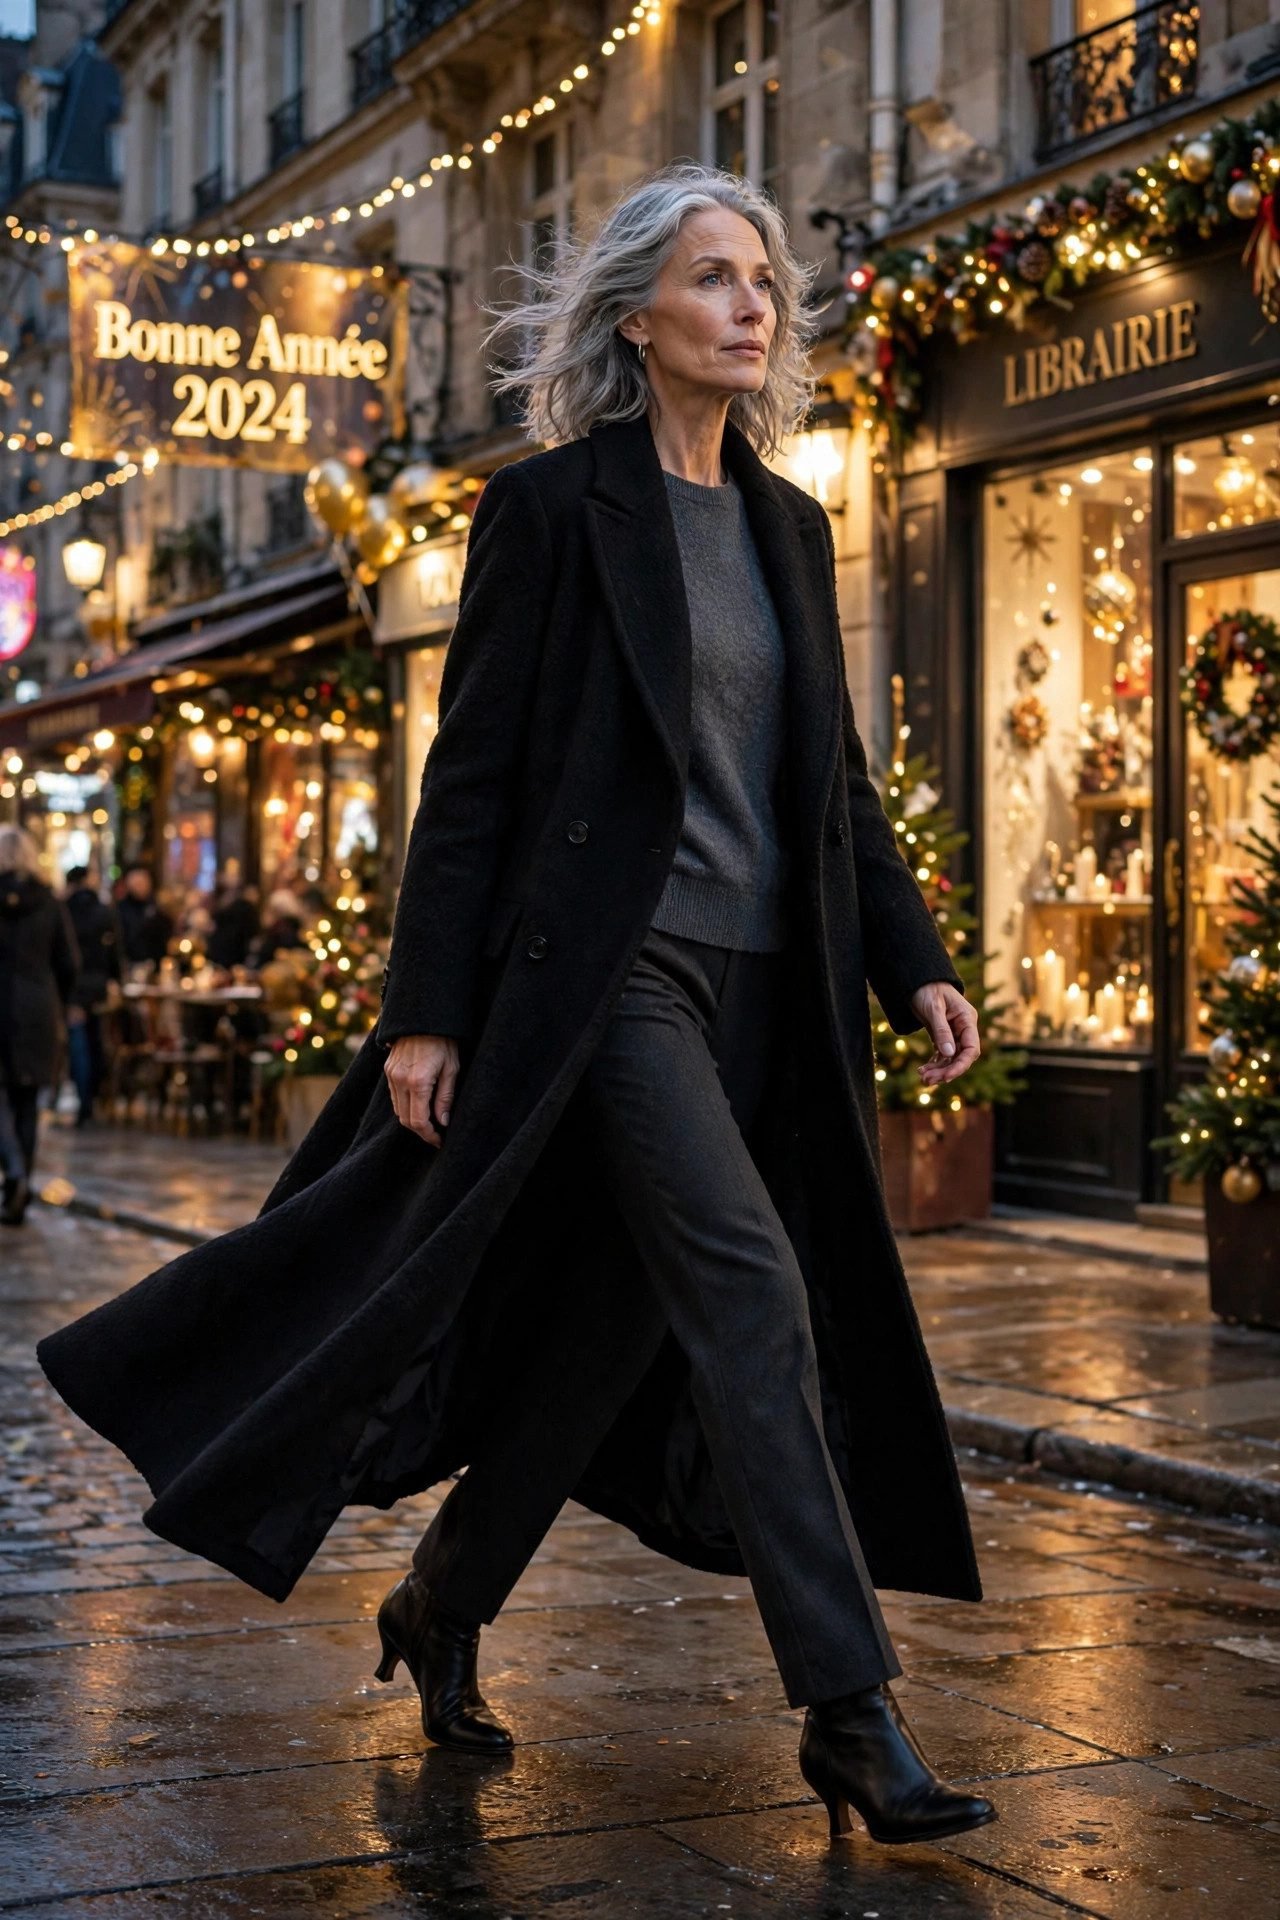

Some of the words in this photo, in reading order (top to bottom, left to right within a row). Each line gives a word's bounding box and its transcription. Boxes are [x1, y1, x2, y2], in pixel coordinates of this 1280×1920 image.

[93, 300, 241, 368] Bonne
[246, 314, 388, 380] Année
[1004, 301, 1197, 407] LIBRAIRIE
[172, 374, 312, 444] 2024
